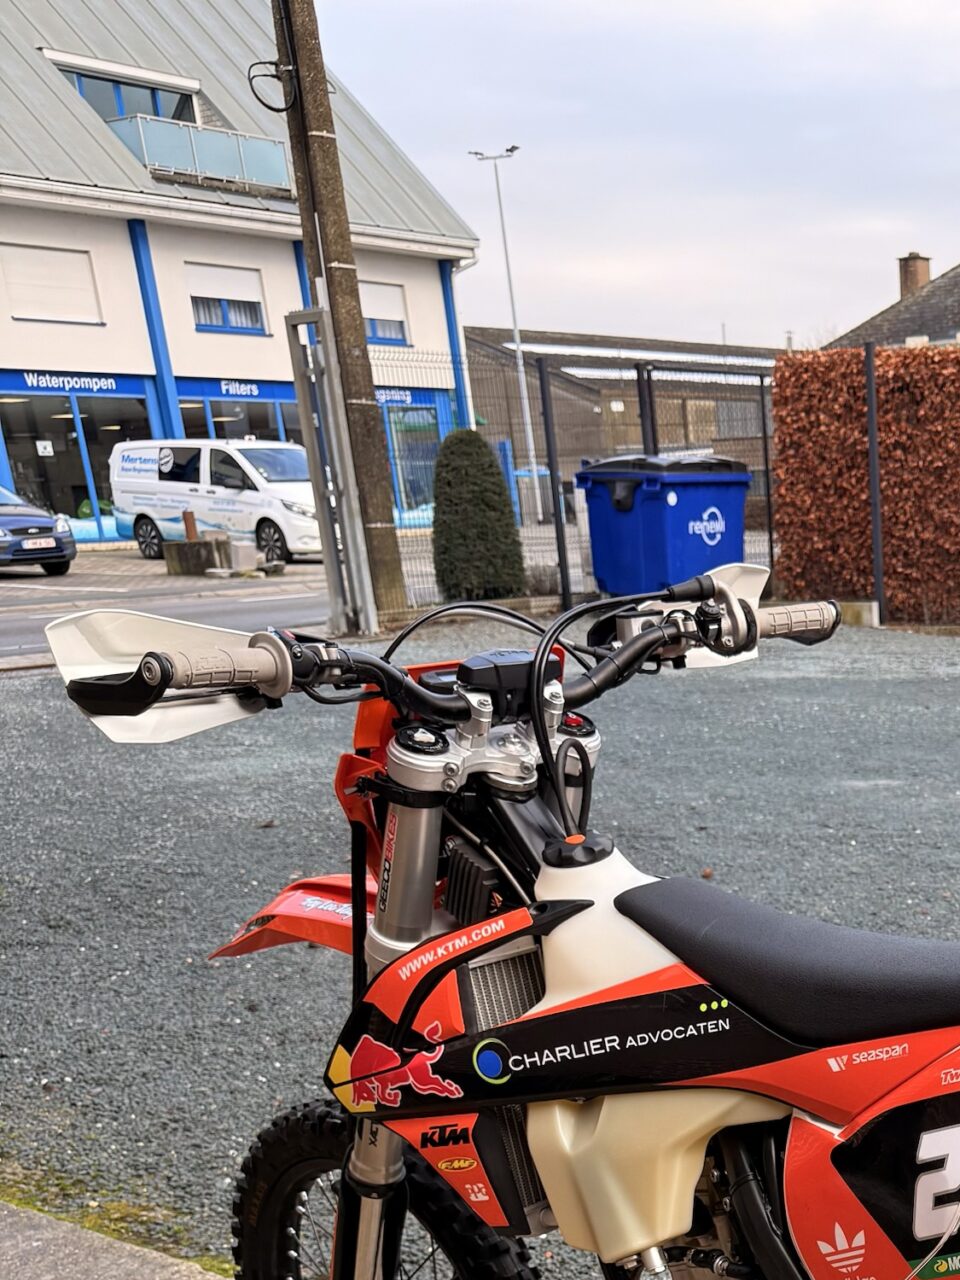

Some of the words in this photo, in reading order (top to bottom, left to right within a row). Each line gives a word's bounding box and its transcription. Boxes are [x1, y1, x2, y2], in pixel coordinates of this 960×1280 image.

[23, 372, 117, 392] Waterpompen
[220, 380, 260, 396] Filters
[379, 812, 398, 913] GEECOBIKES
[398, 919, 506, 982] WWW.KTM.COM
[508, 1034, 621, 1073] CHARLIER
[625, 1017, 731, 1050] ADVOCATEN
[851, 1042, 909, 1065] seaspan
[420, 1123, 471, 1149] KTM
[441, 1159, 475, 1170] FMF
